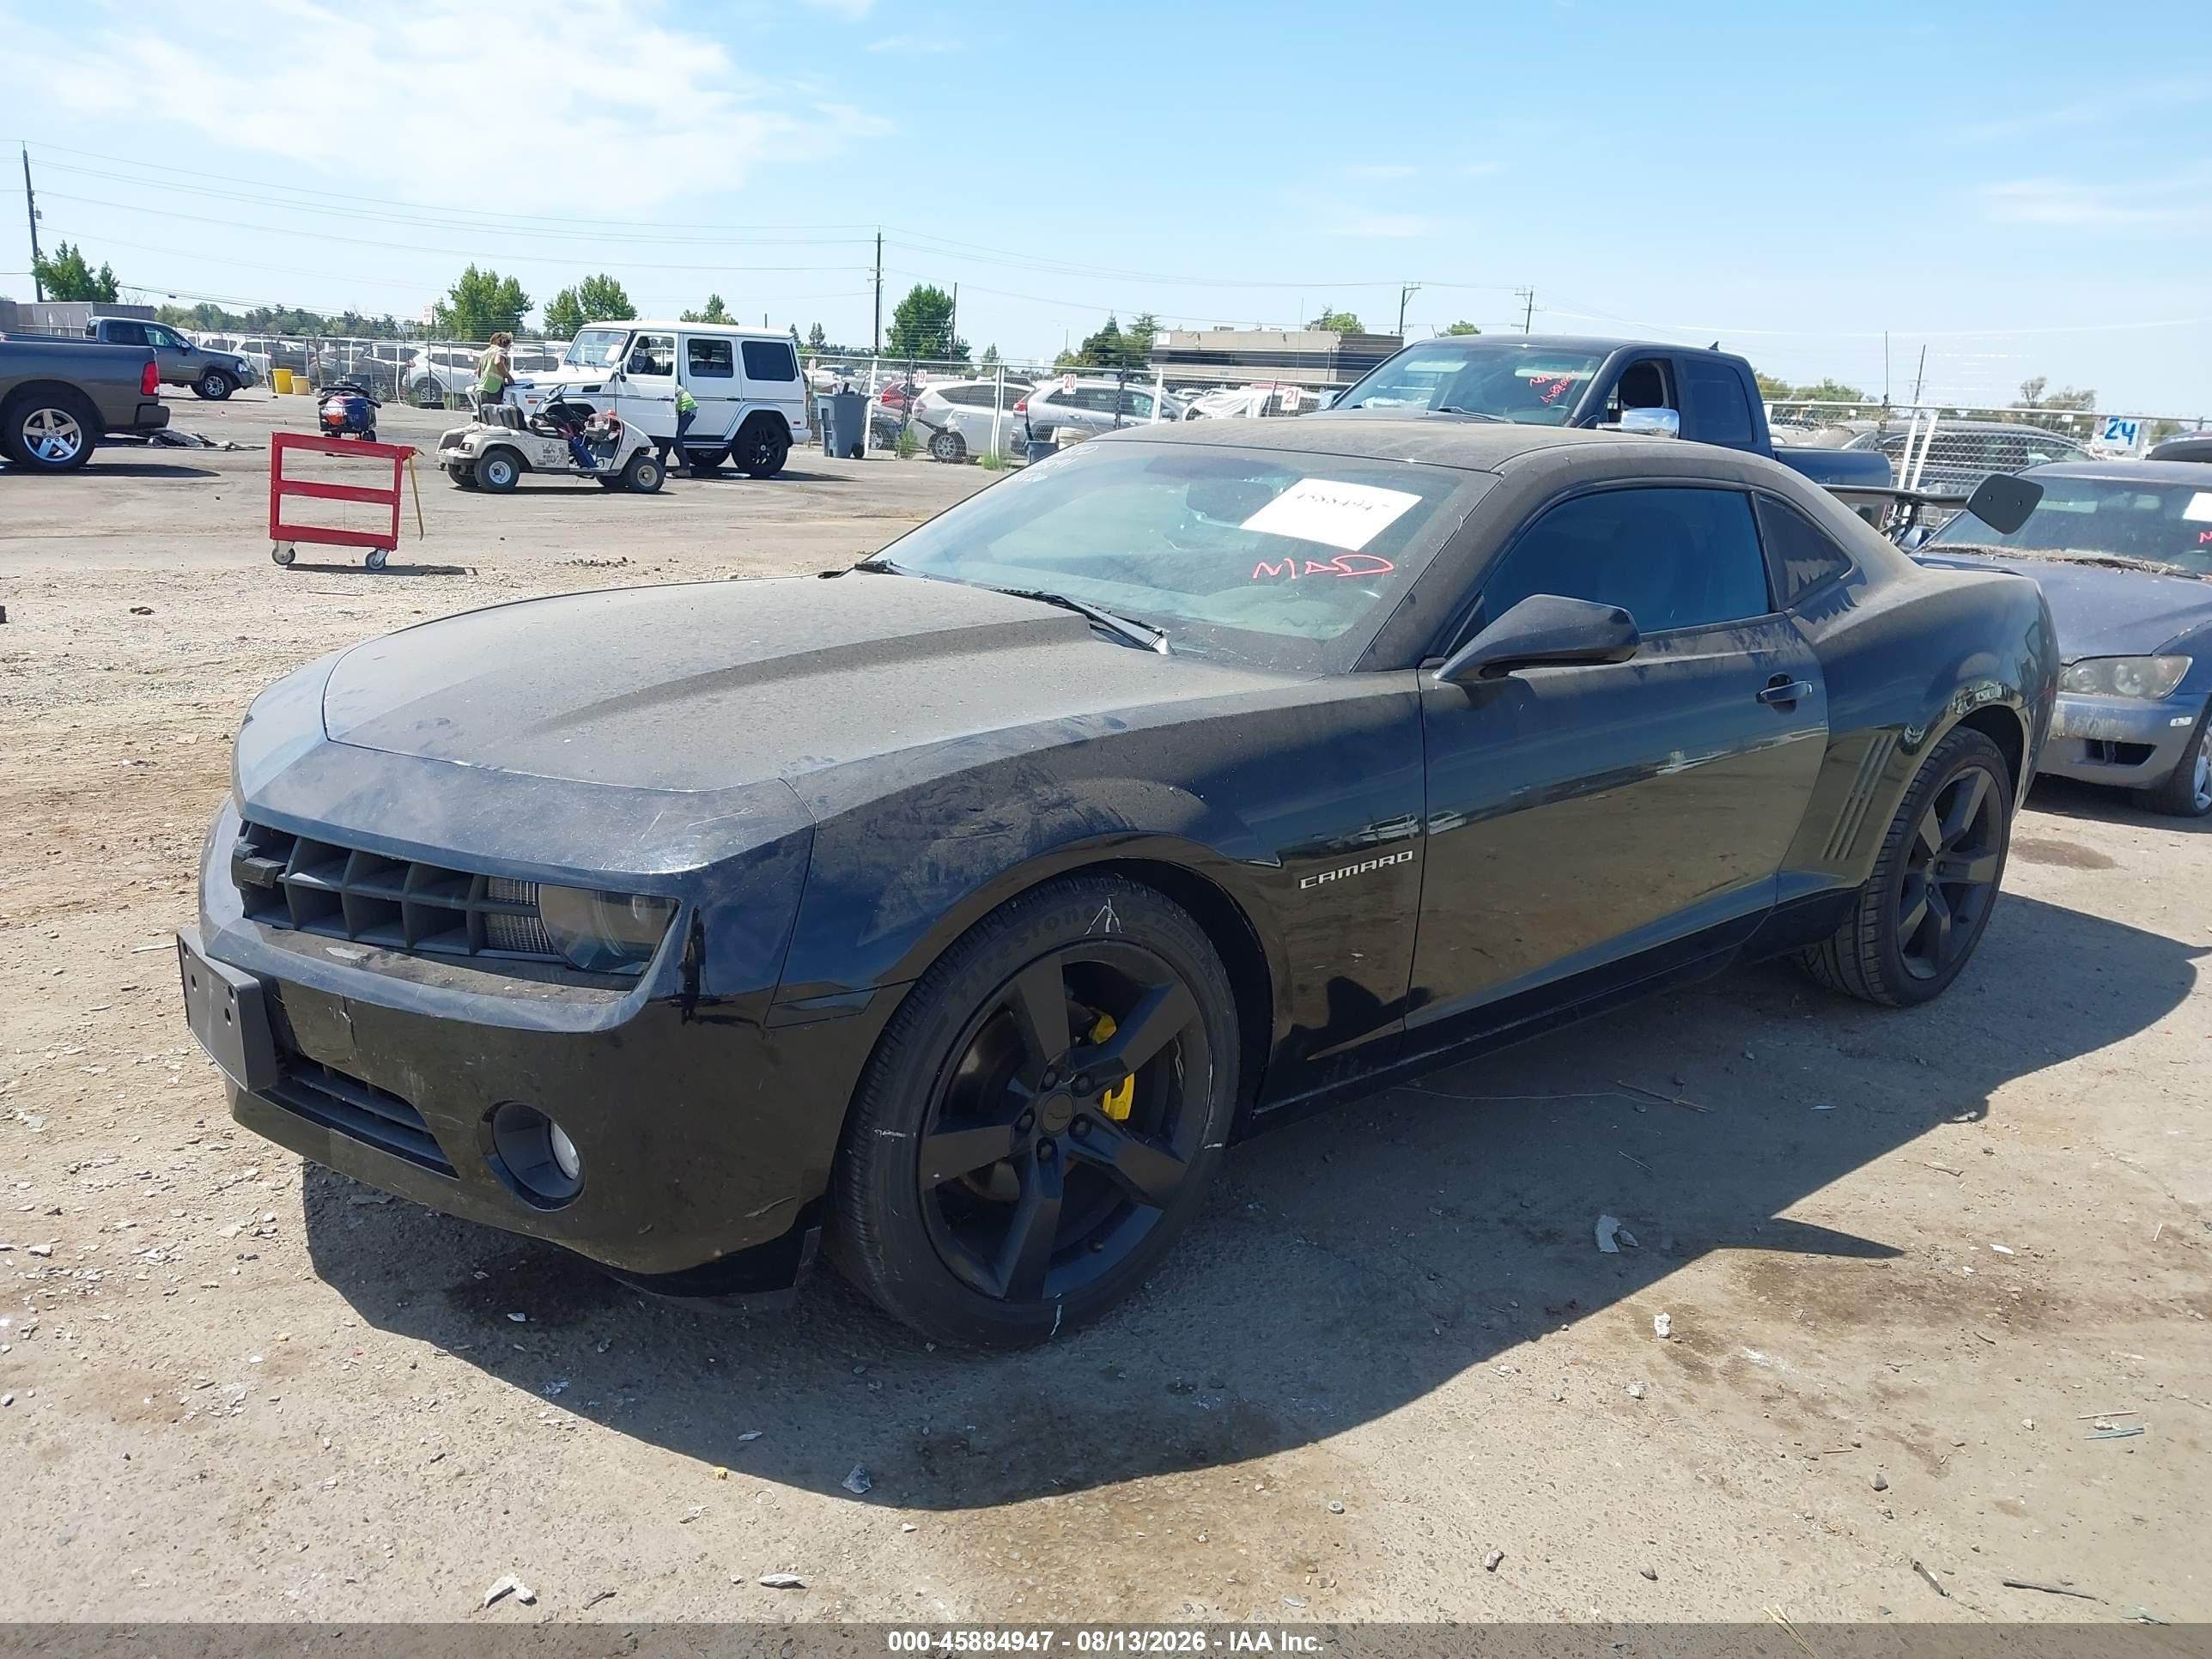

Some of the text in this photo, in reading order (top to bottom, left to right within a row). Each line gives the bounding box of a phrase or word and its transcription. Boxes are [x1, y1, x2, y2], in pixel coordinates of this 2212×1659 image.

[915, 371, 925, 383] 19
[1065, 374, 1075, 388] 20
[1285, 389, 1299, 404] 21
[2105, 416, 2136, 446] 24
[1253, 554, 1395, 580] MAD
[1299, 850, 1413, 890] CAMARO
